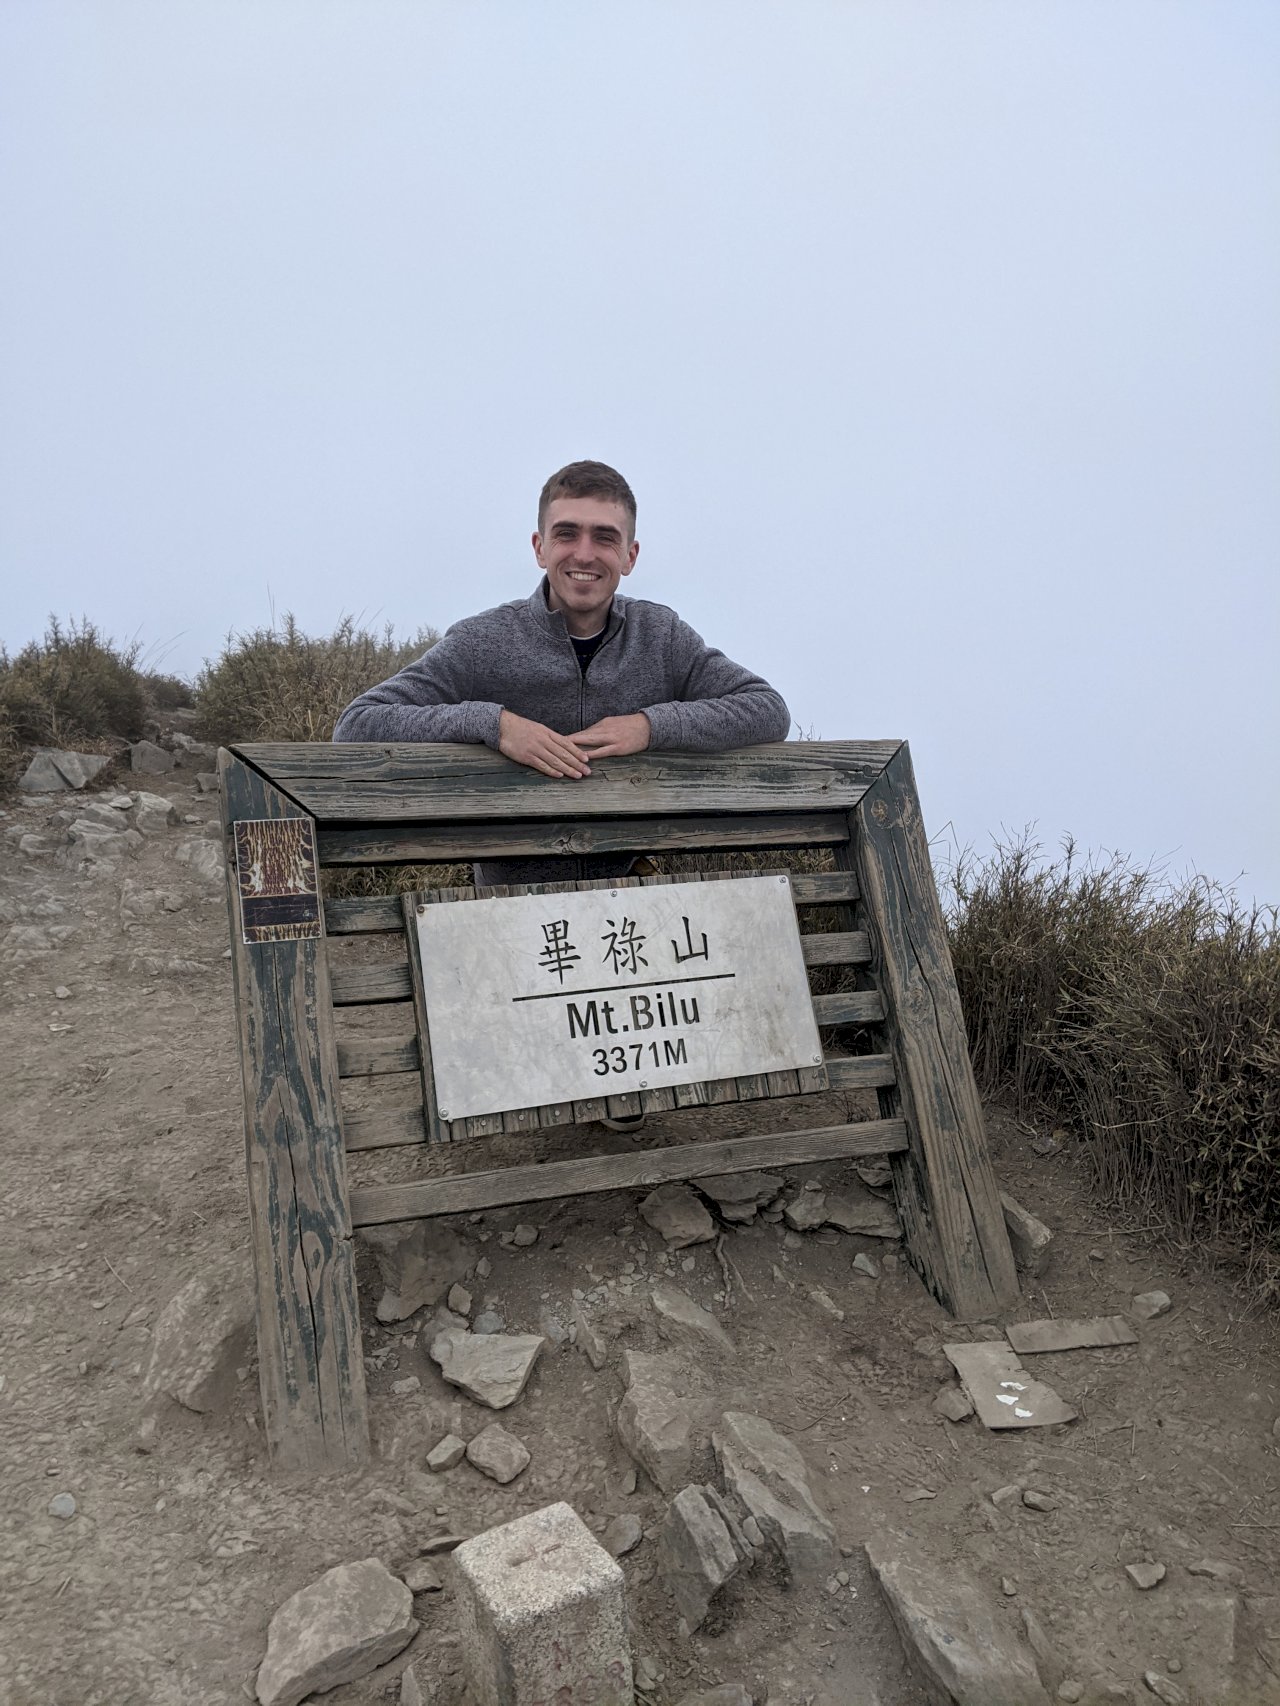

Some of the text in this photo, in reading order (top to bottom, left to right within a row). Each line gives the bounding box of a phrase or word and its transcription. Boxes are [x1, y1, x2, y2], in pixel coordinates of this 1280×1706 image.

[538, 916, 709, 985] 畢祿山
[566, 992, 700, 1039] Mt.Bilu
[592, 1038, 688, 1076] 3371M
